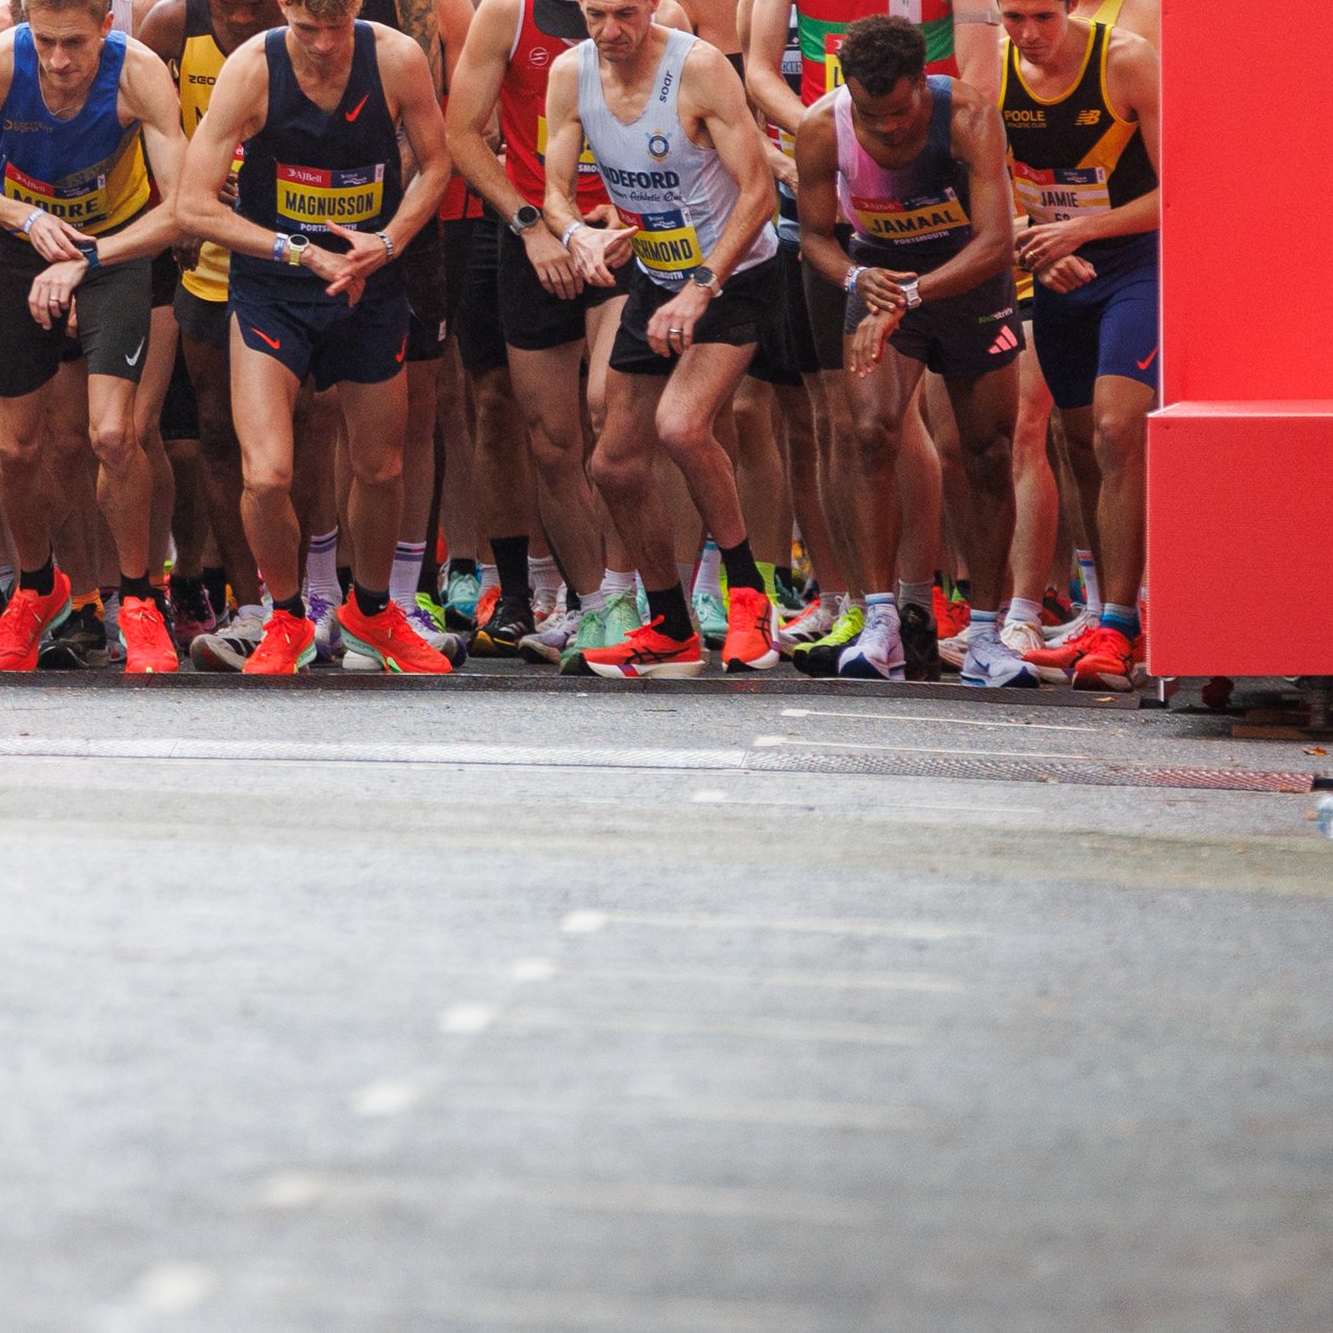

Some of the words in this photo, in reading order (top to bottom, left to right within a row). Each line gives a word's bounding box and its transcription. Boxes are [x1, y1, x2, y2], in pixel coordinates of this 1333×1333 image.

[659, 70, 675, 103] soar
[1004, 110, 1046, 122] POOLE
[284, 190, 374, 217] MAGNUSSON
[1041, 191, 1079, 208] JAMIE
[871, 209, 960, 234] JAMAAL
[893, 230, 950, 246] PORTSMOUTH
